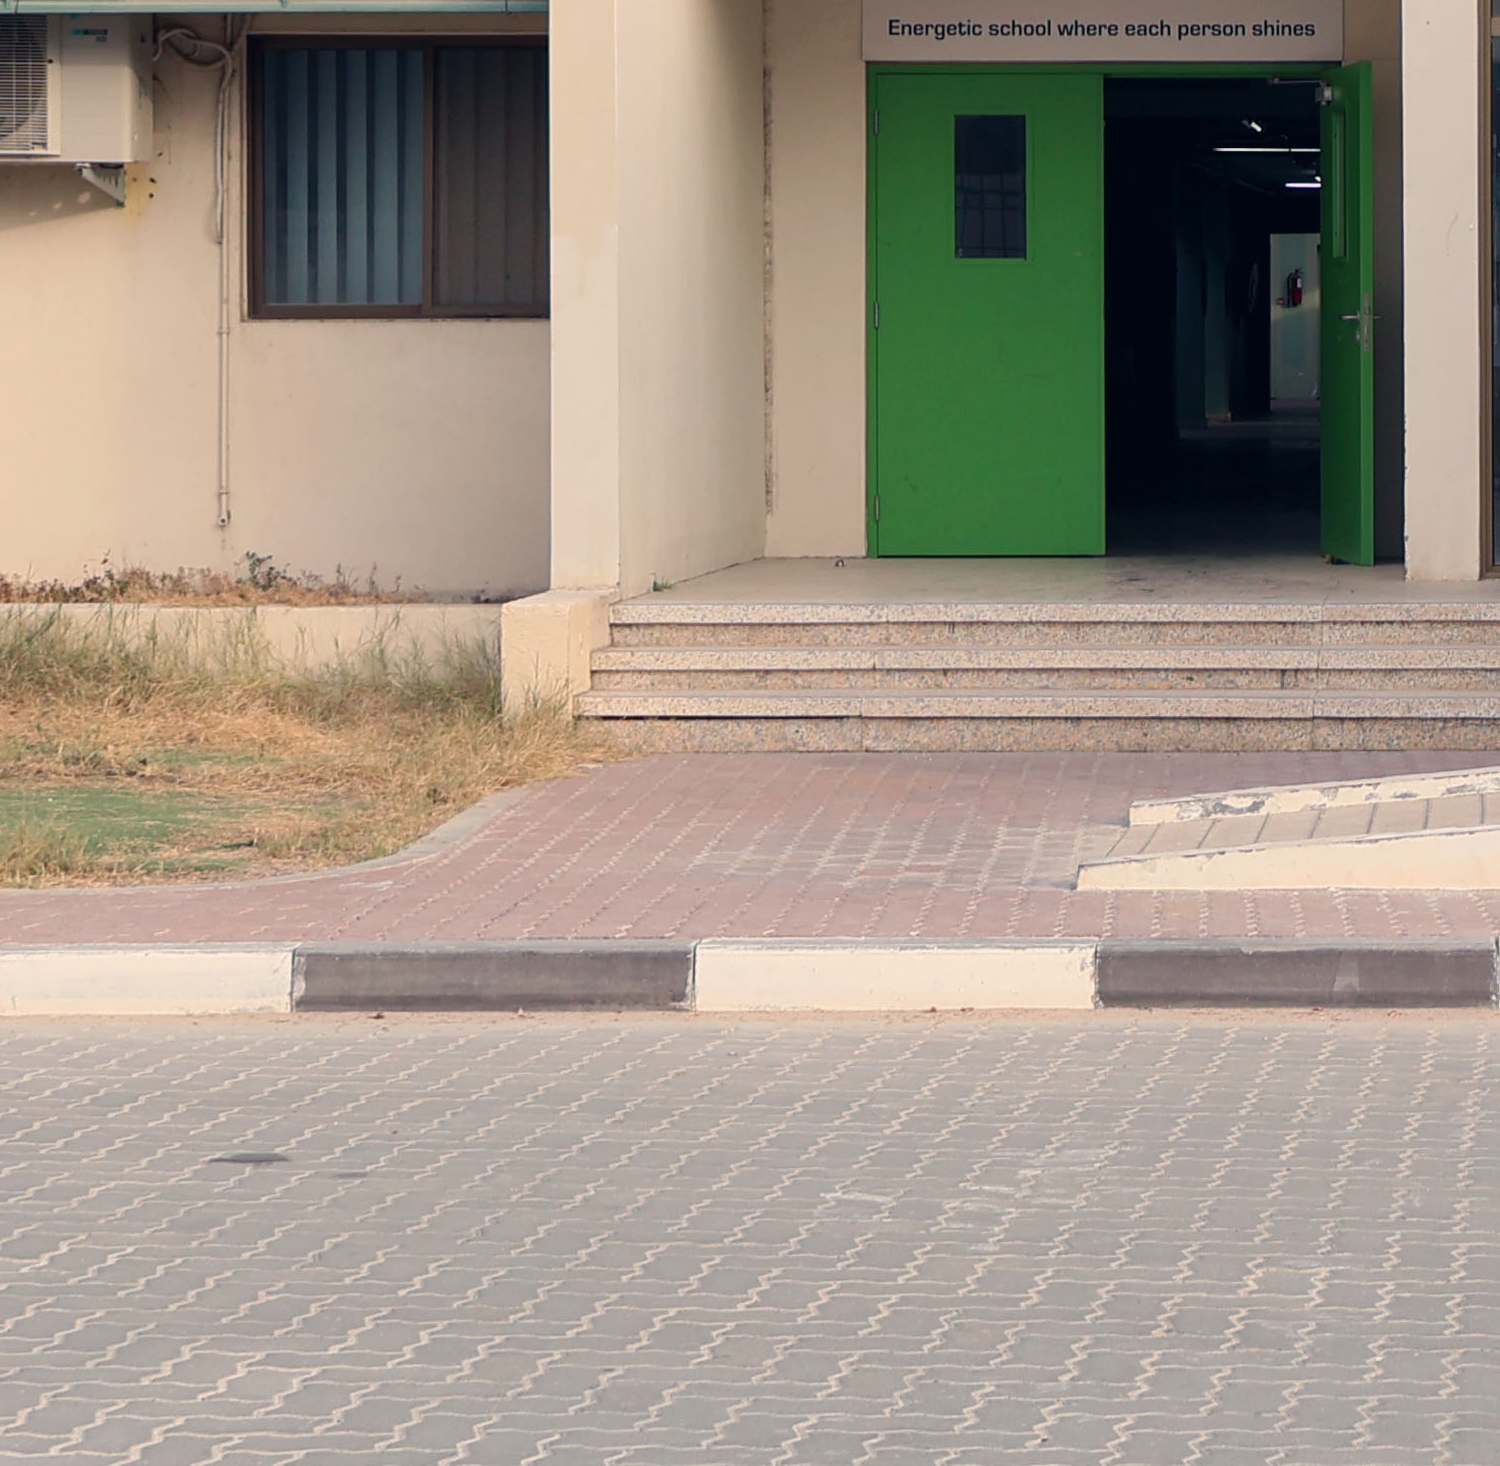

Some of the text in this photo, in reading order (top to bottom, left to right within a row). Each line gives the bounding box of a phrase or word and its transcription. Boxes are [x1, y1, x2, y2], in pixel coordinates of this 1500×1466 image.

[888, 19, 1316, 41] Energetic school where each person shines
